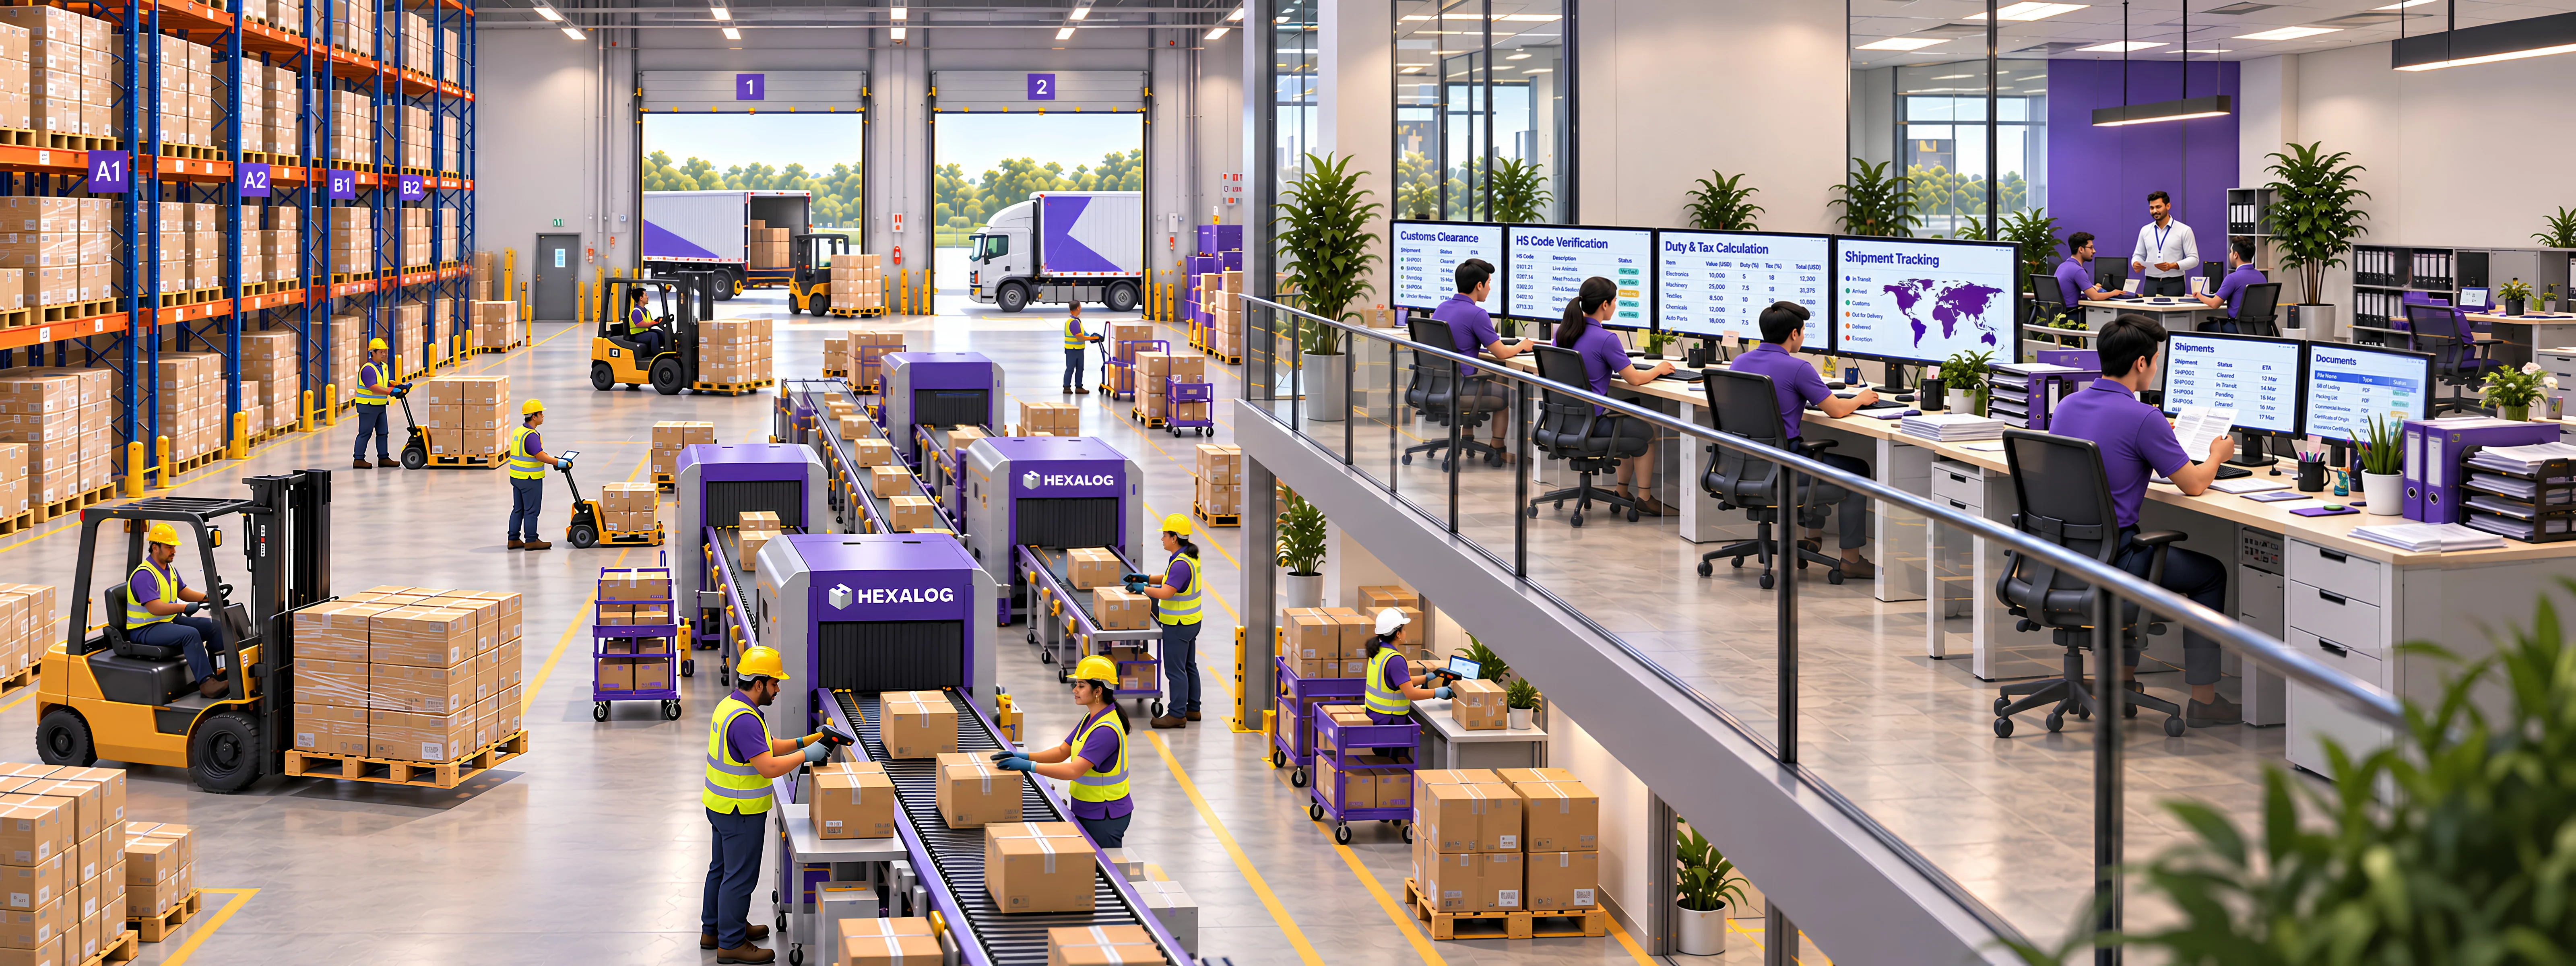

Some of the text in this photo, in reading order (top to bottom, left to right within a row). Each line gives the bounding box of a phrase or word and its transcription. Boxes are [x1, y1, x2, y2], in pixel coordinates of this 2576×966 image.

[746, 80, 753, 94] 1
[1037, 80, 1047, 94] 2
[96, 161, 120, 182] A1
[244, 171, 266, 188] A2
[334, 178, 350, 192] B1
[404, 182, 419, 194] B2
[1401, 231, 1478, 242] Customs Clearance
[1517, 236, 1608, 248] HS Code Verification
[1666, 241, 1768, 254] Duty & Tax Calculation
[1846, 251, 1939, 268] Shipment Tracking
[2175, 343, 2214, 353] Shipments
[2316, 355, 2356, 365] Documents
[1045, 475, 1113, 485] HEXALOG
[859, 588, 953, 603] HEXALOG
